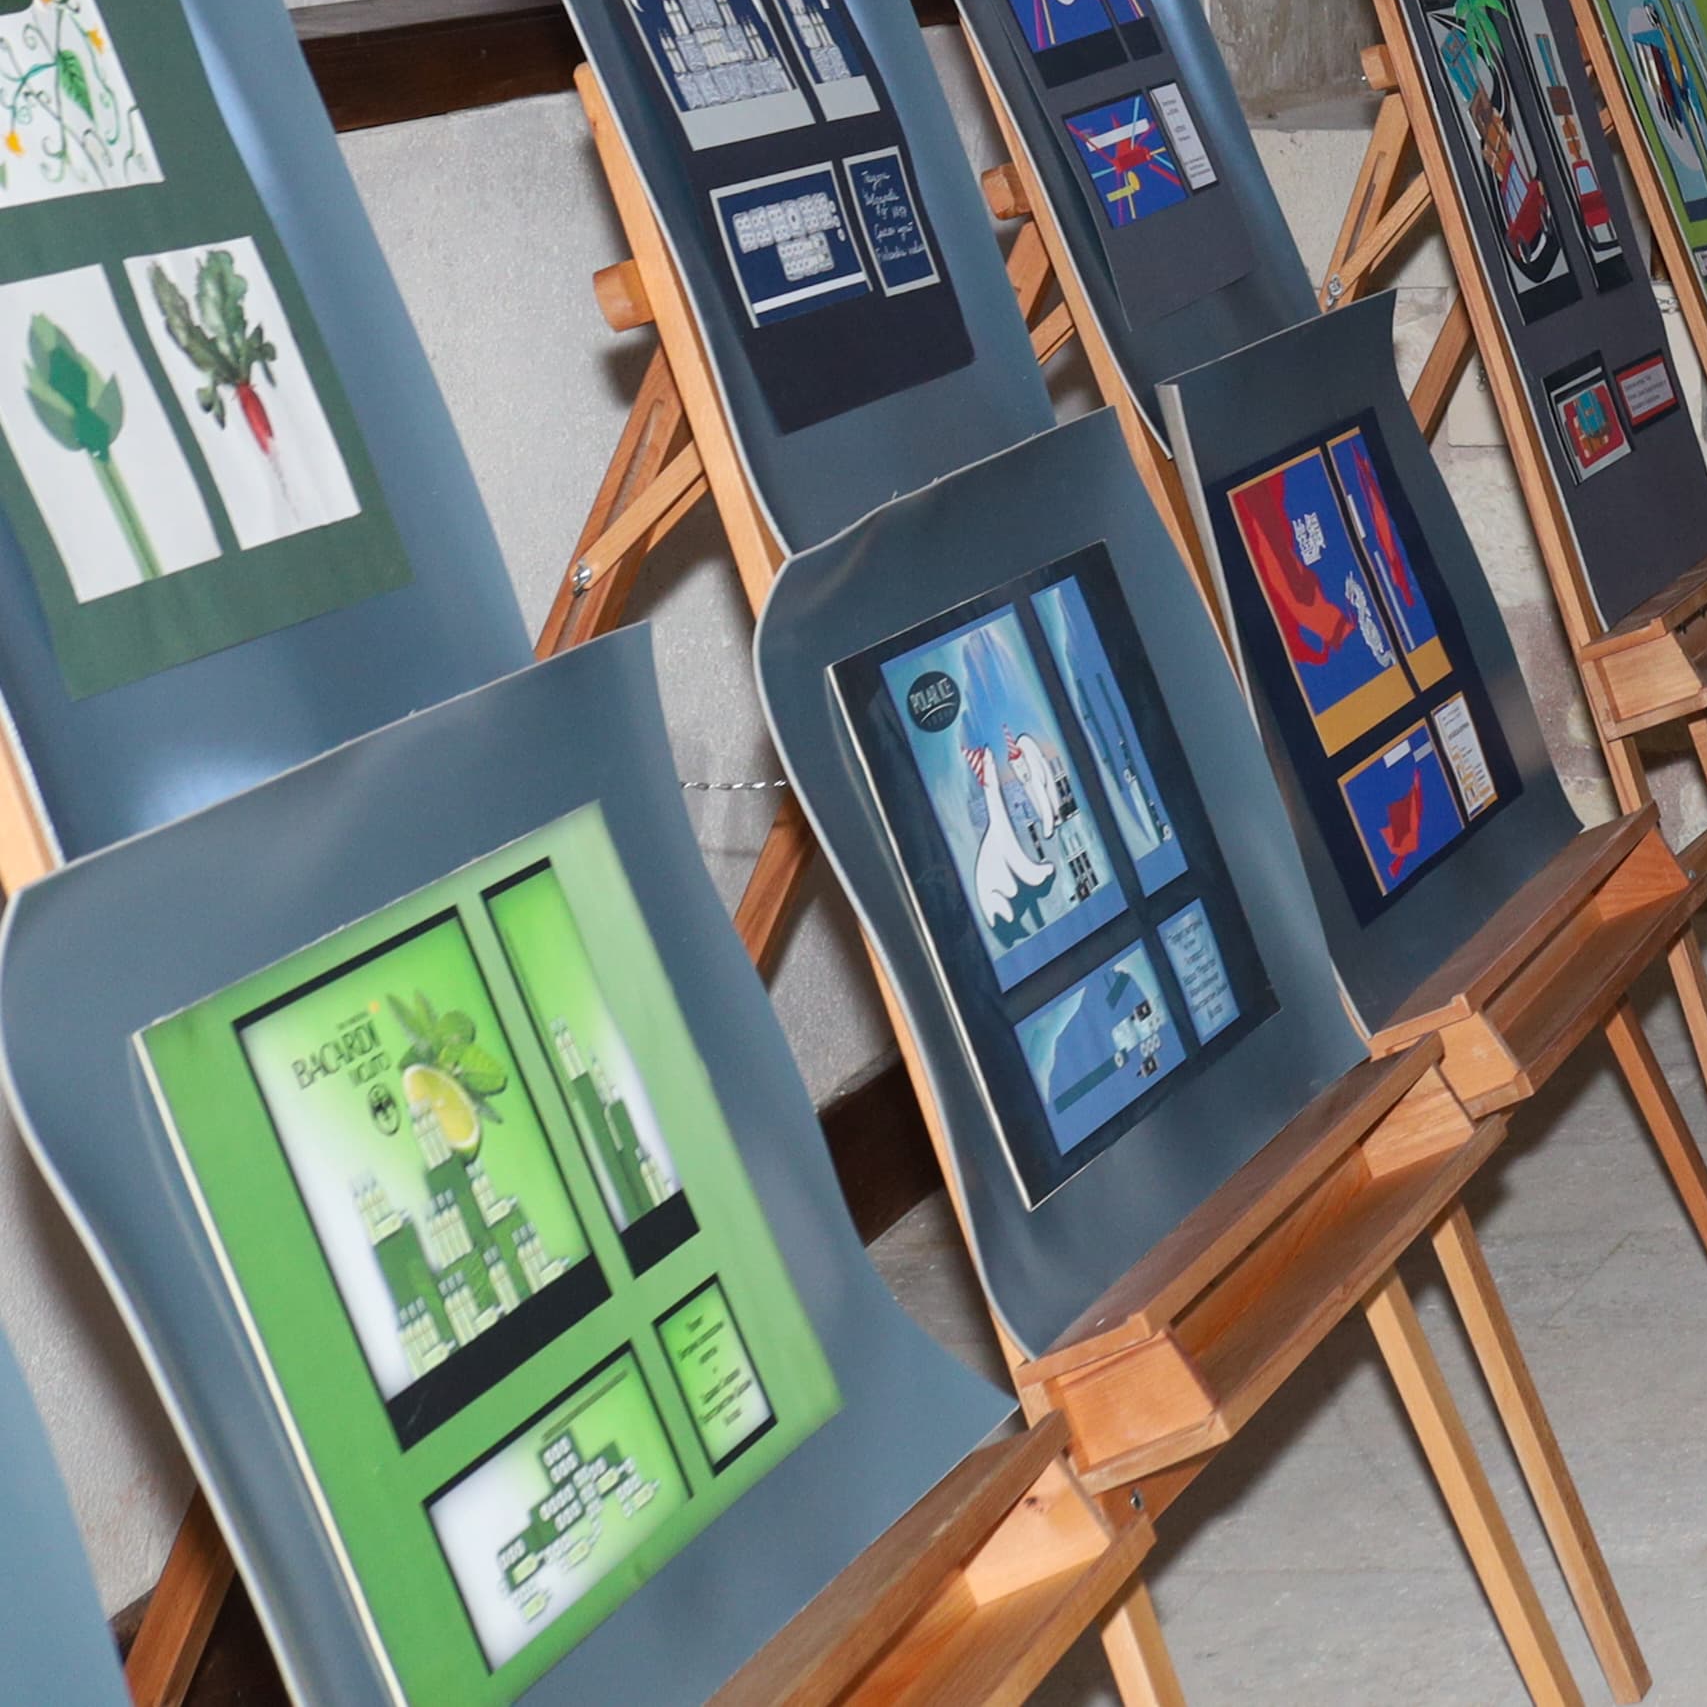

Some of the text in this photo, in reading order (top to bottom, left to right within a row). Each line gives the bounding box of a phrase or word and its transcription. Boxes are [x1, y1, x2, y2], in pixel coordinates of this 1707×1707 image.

[909, 677, 955, 715] POLAR ICE
[291, 1020, 381, 1090] BACARDI
